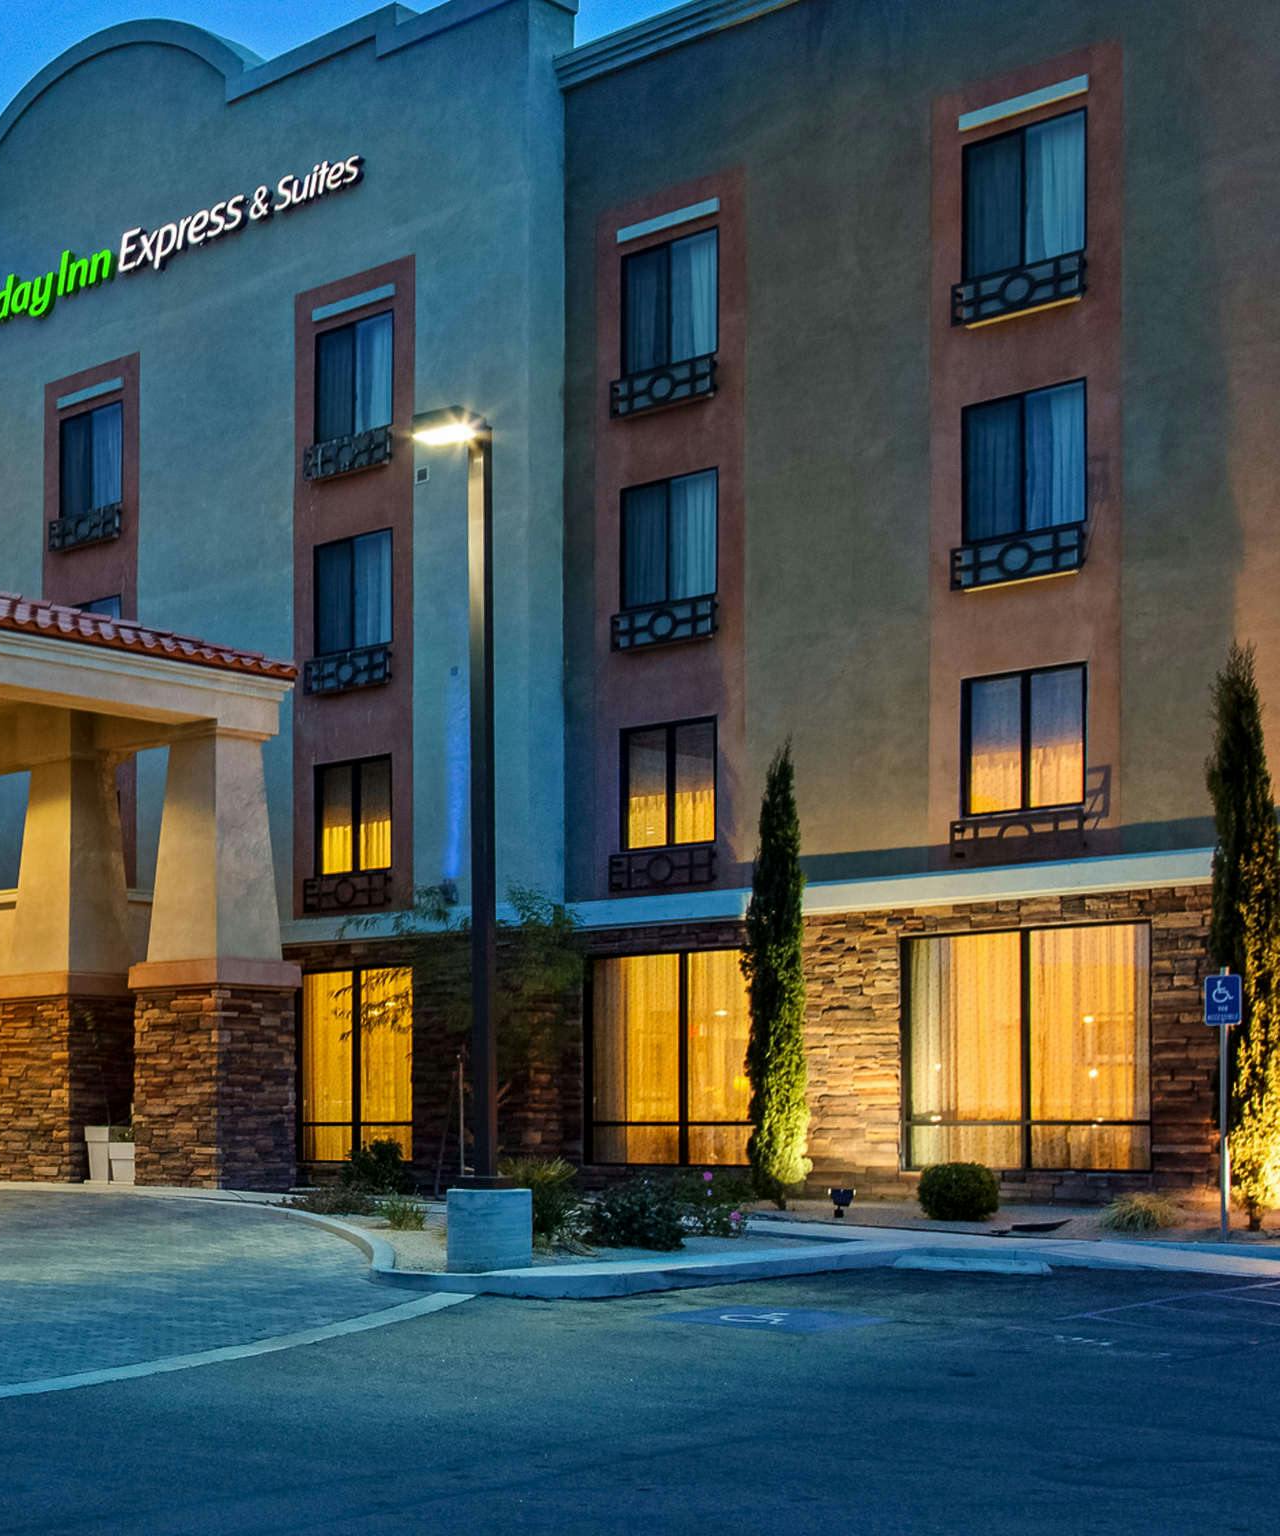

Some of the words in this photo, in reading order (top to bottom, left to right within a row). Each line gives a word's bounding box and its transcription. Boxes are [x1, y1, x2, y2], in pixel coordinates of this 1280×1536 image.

[56, 248, 112, 297] Inn
[117, 194, 246, 273] Express
[248, 184, 270, 221] &
[273, 154, 361, 212] Suites
